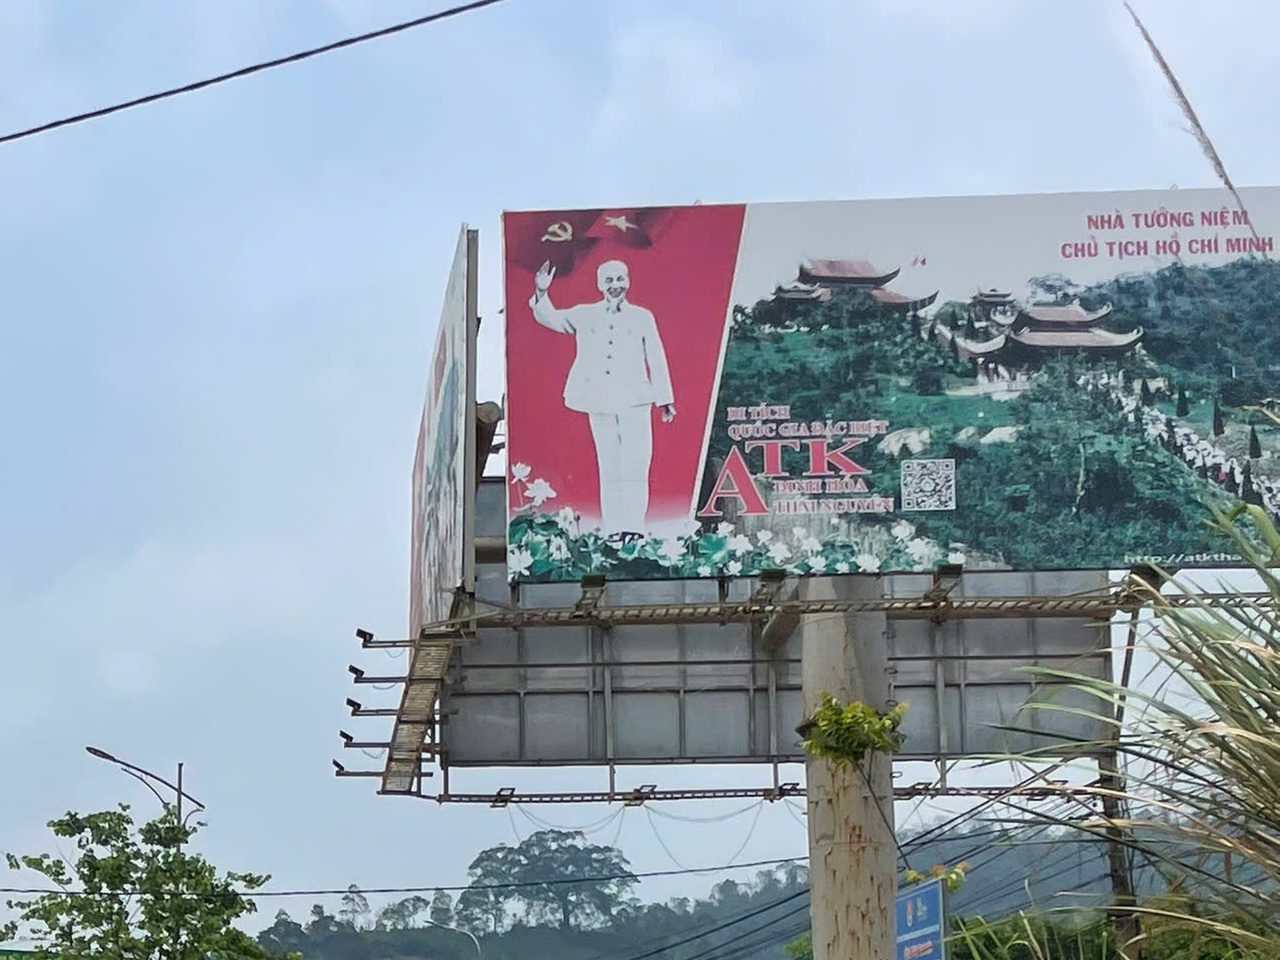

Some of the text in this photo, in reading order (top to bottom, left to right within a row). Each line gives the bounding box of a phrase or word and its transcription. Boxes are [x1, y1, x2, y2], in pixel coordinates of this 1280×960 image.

[1086, 208, 1125, 230] NHÀ
[1200, 206, 1249, 229] NIỆM
[1061, 234, 1099, 259] CHỦ
[1105, 240, 1149, 260] TỊCH
[1188, 232, 1219, 255] CHÍ
[1225, 237, 1274, 253] MINH
[727, 420, 776, 441] QUỐC
[778, 422, 810, 437] GIA
[697, 437, 872, 517] ATK
